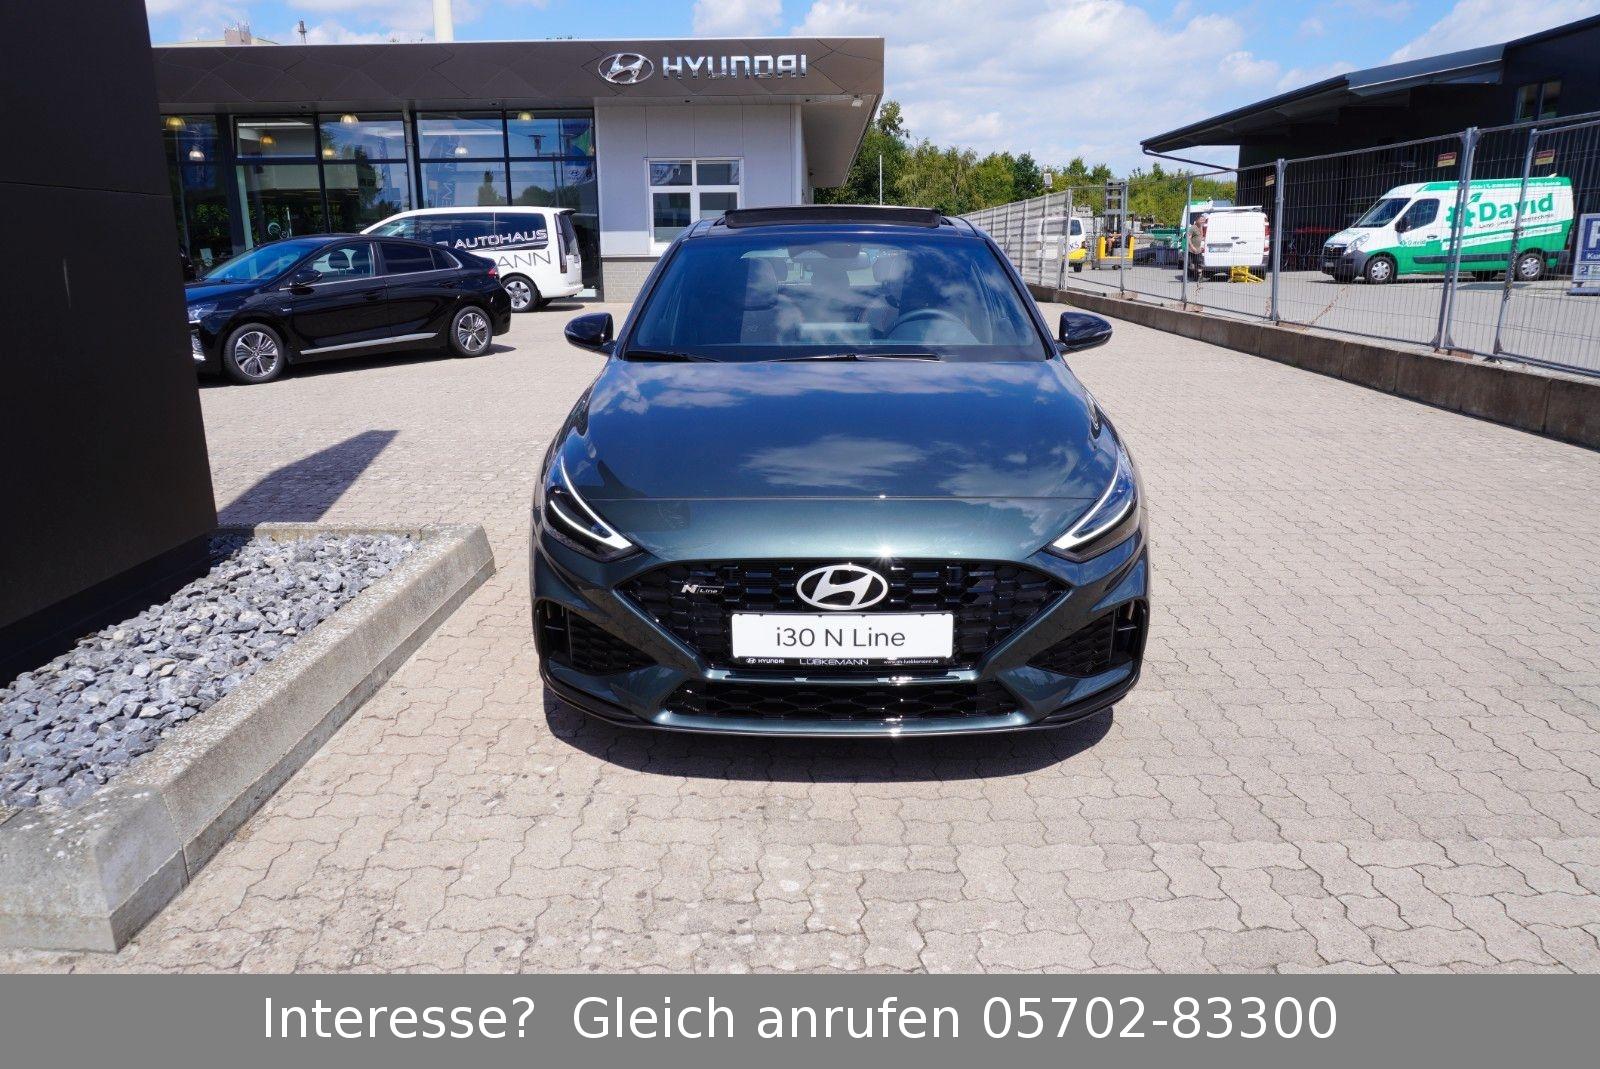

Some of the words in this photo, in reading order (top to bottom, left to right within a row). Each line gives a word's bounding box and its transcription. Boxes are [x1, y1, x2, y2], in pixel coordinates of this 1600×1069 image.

[662, 54, 807, 79] HYUNDAI
[1479, 193, 1554, 223] David
[454, 229, 548, 249] AUTOHAUS
[776, 627, 815, 647] i30
[825, 628, 843, 647] N
[853, 627, 906, 647] Line
[799, 658, 869, 666] LÜBKEMANN
